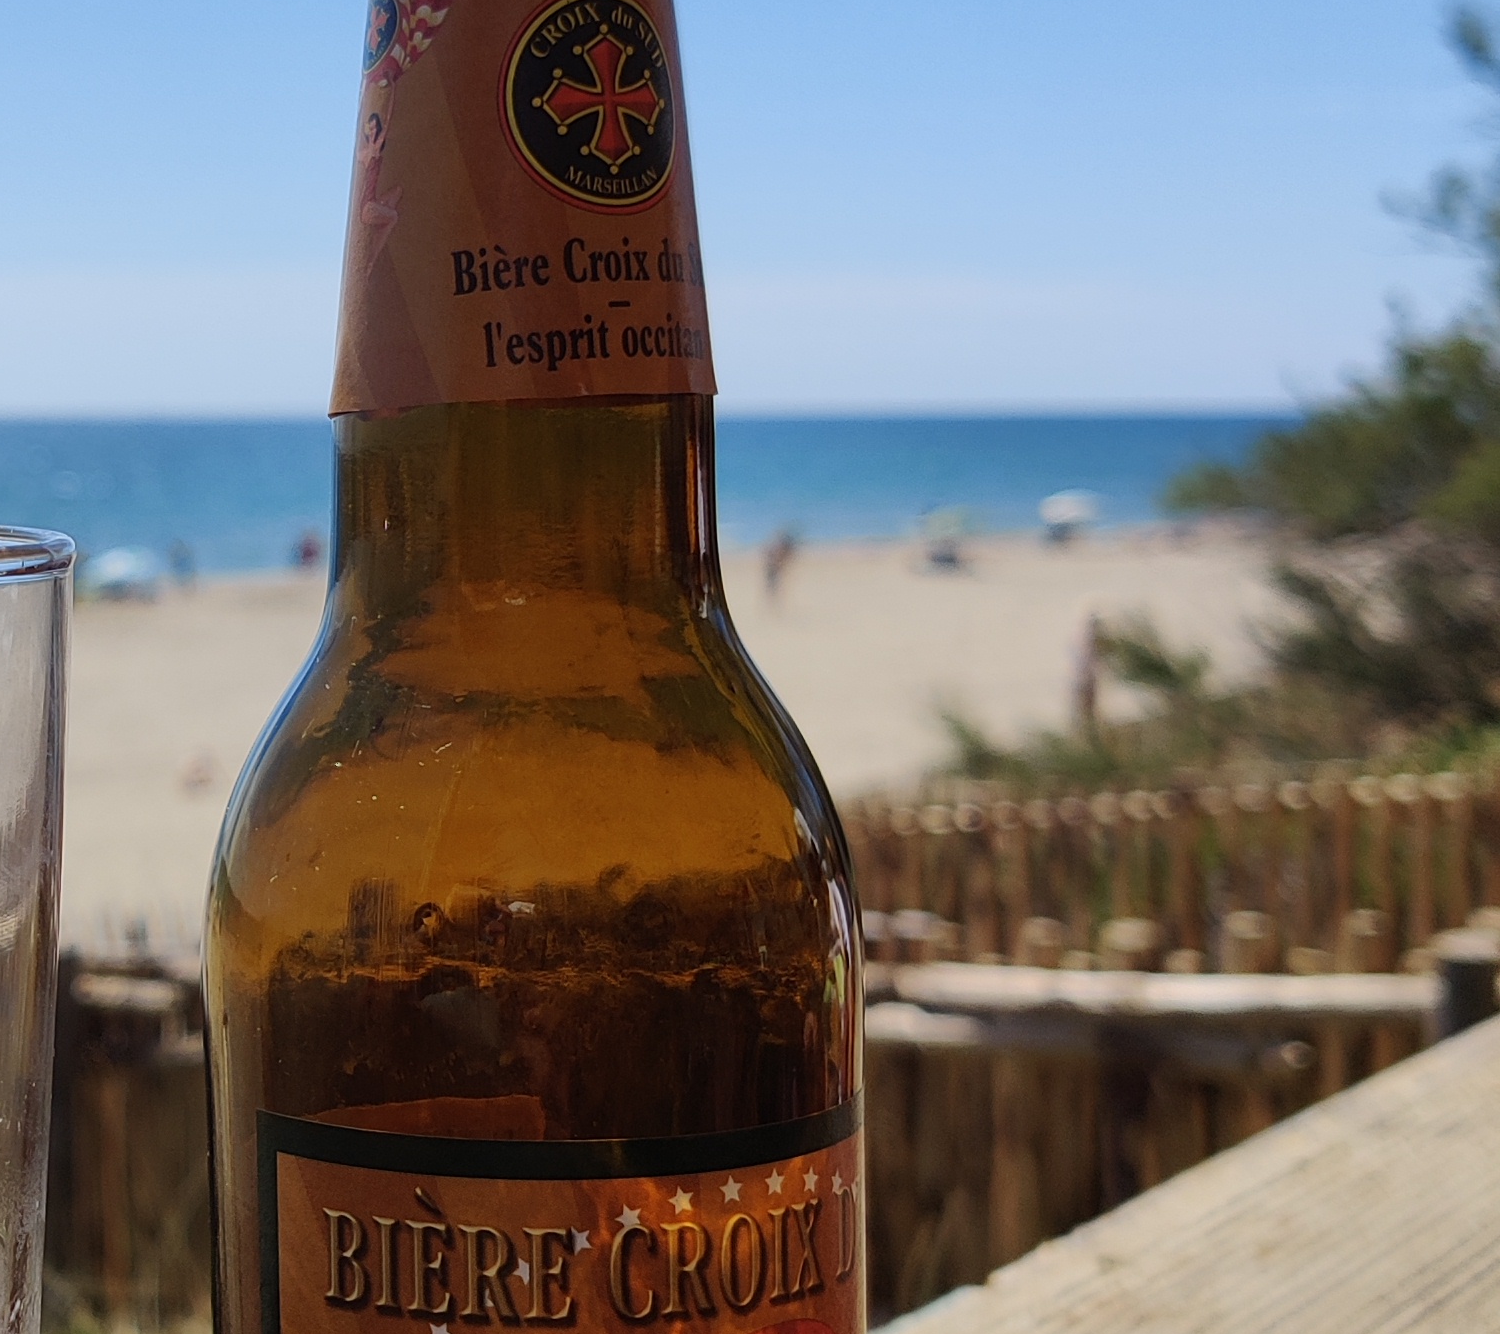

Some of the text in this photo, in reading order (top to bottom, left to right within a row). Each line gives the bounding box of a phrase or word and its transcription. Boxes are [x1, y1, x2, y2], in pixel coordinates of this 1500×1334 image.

[530, 2, 664, 69] CROIX du SUD
[565, 165, 660, 196] MARSEILLAN
[452, 244, 551, 296] Bière
[562, 236, 651, 284] Croix
[657, 237, 684, 283] du
[482, 314, 611, 372] l'esprit
[323, 1186, 578, 1327] BIÈRE
[609, 1197, 824, 1323] CROIX
